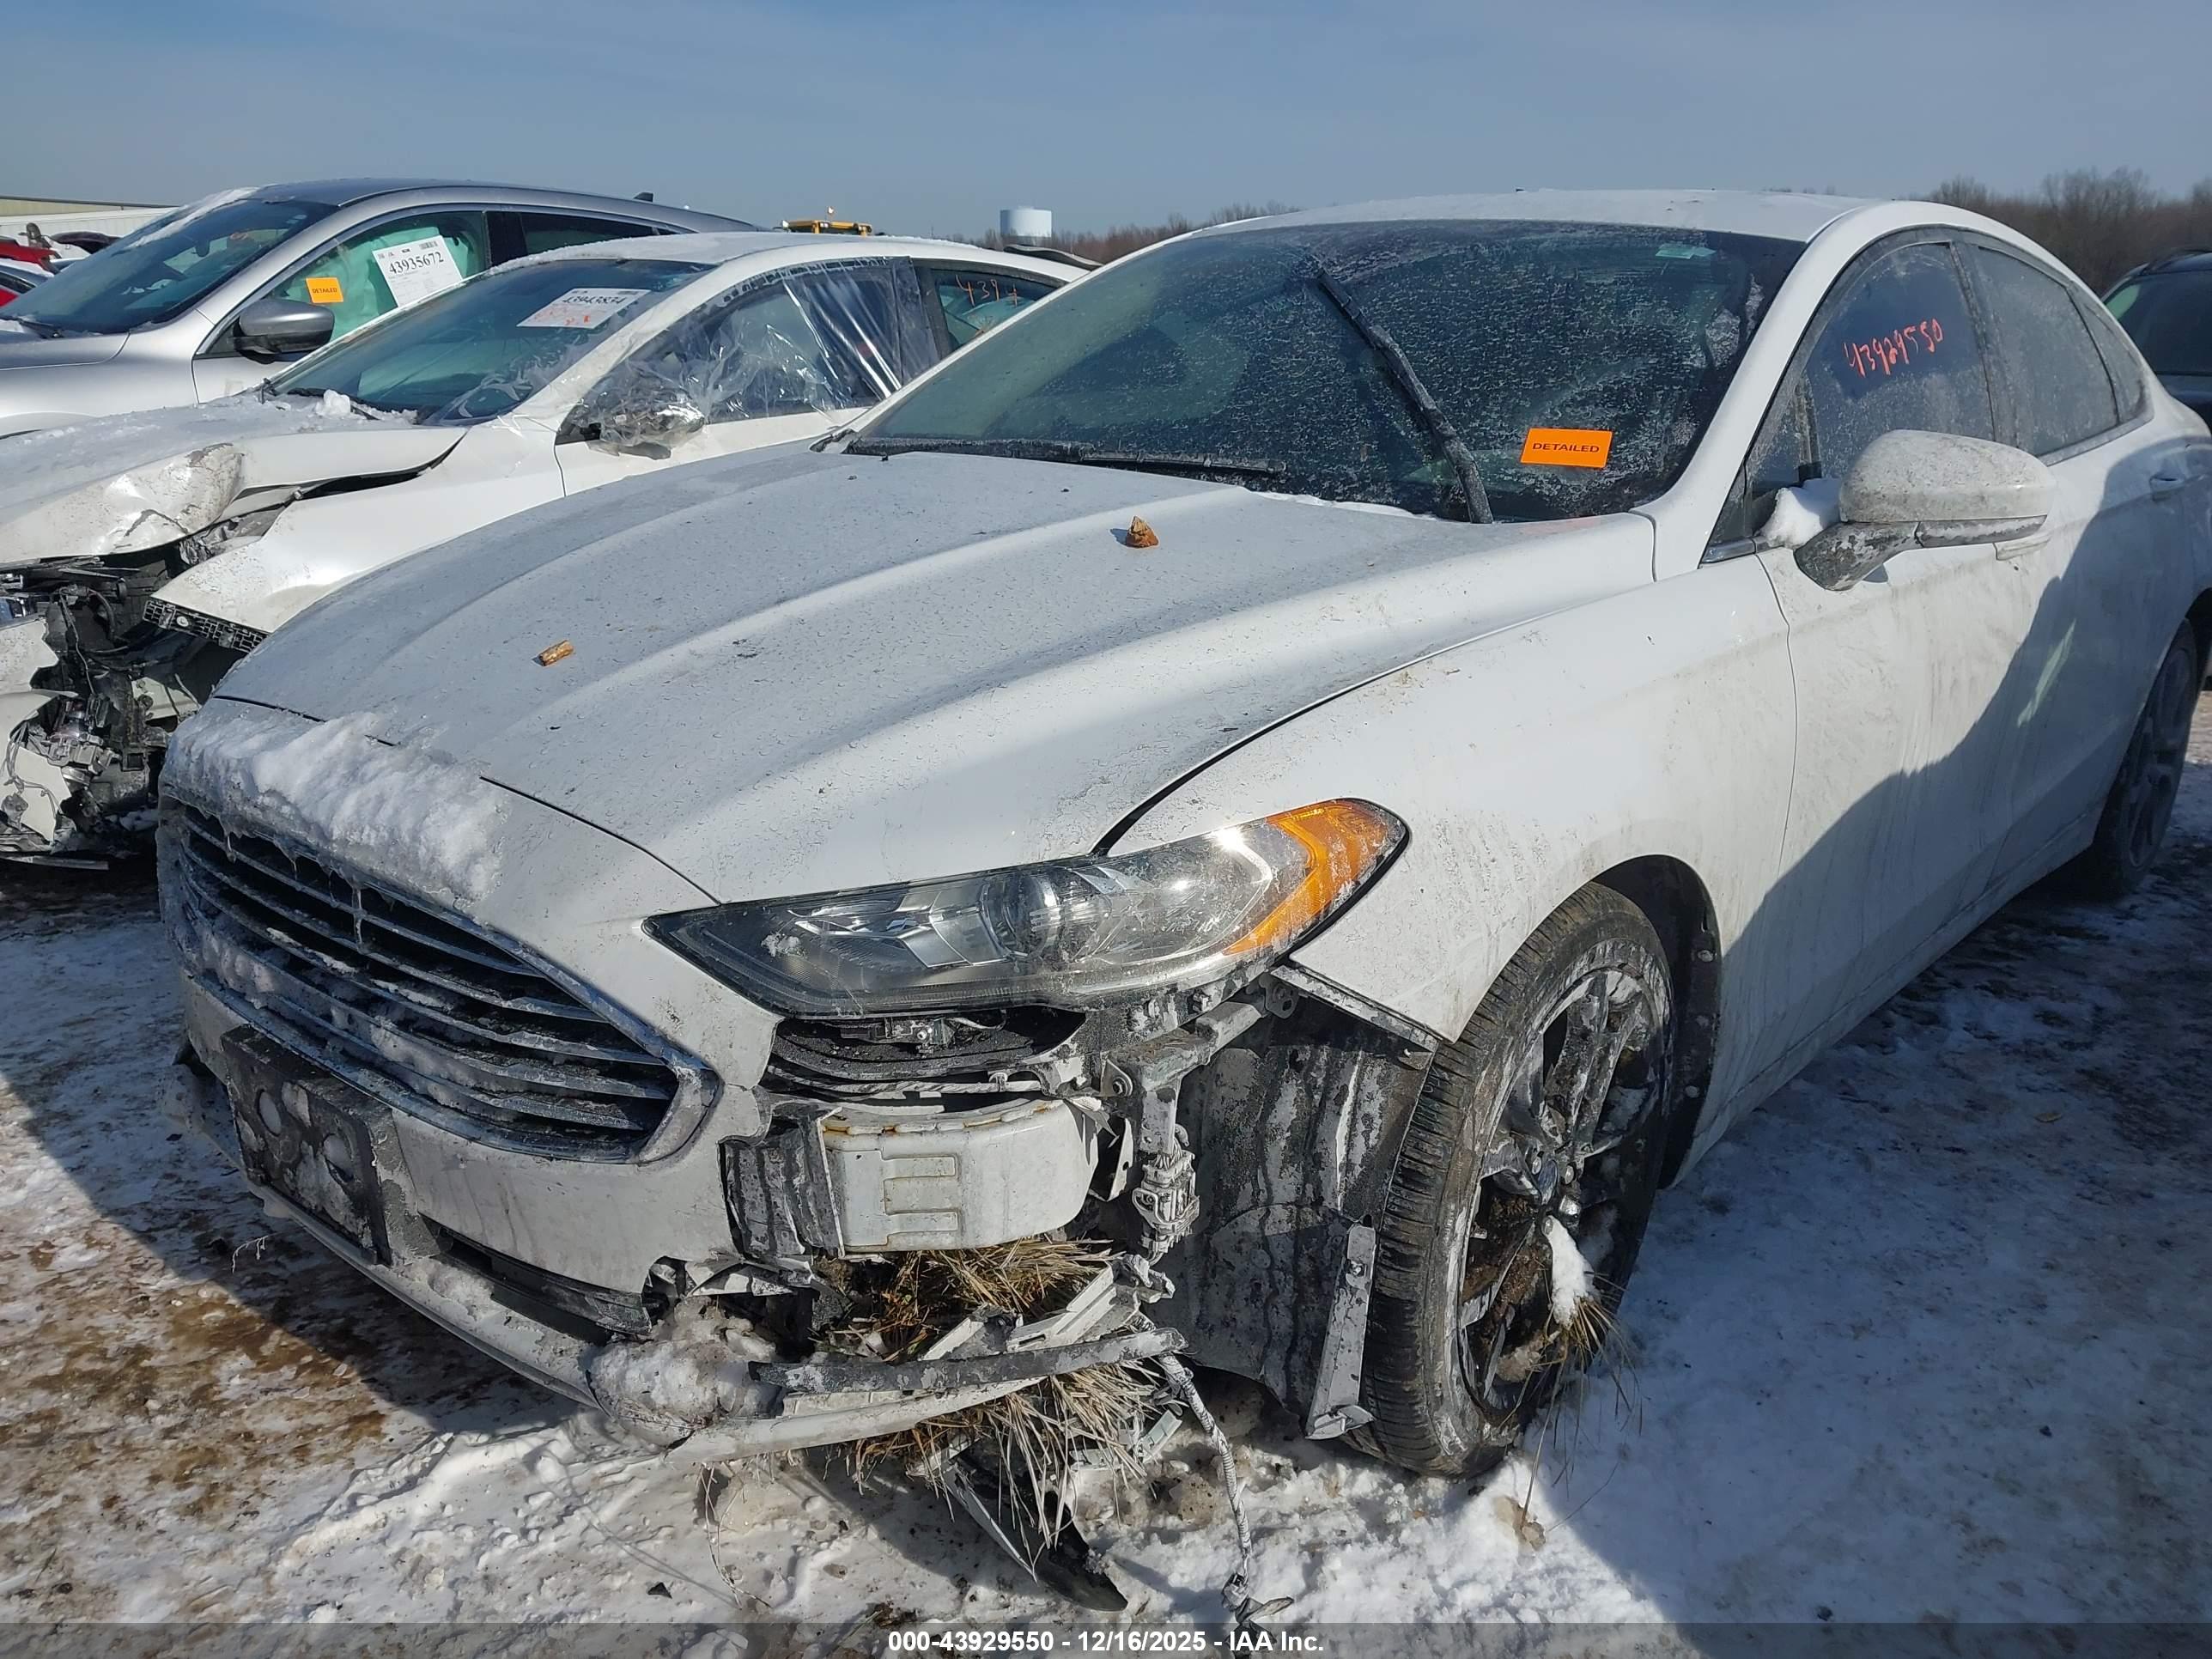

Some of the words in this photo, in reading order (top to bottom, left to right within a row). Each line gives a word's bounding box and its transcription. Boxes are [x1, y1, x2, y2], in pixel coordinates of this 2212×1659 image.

[389, 252, 444, 275] 43935672
[1844, 318, 1943, 377] 43929550
[1532, 442, 1600, 453] DETAILED
